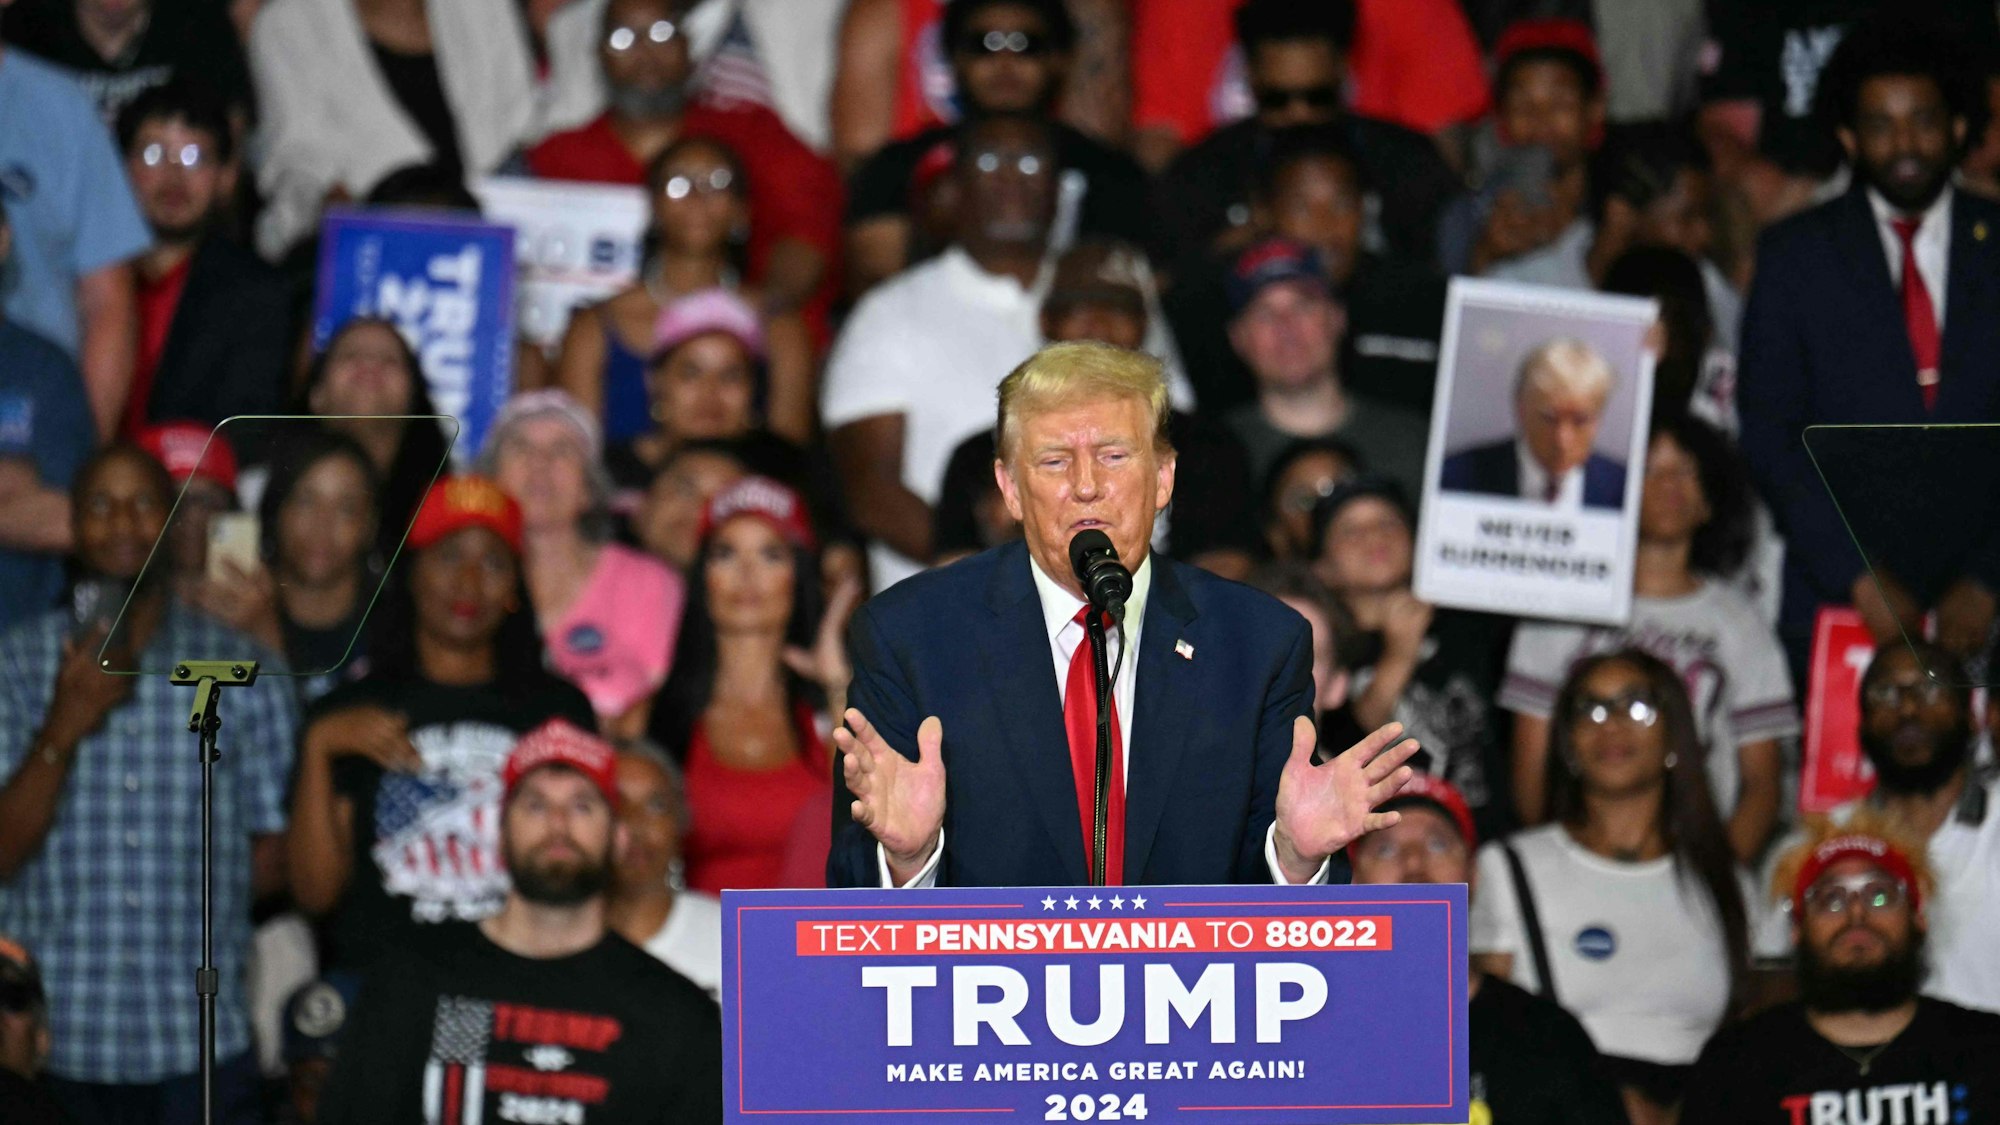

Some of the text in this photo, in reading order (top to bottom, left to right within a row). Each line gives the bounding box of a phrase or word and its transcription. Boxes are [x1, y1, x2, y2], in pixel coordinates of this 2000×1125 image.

[423, 243, 483, 465] TRUM
[813, 920, 1377, 952] TEXT PENNSYLVANIA TO 88022
[861, 962, 1329, 1047] TRUMP
[887, 1060, 1305, 1082] MAKE AMERICA GREAT AGAIN!
[1044, 1093, 1148, 1121] 2024
